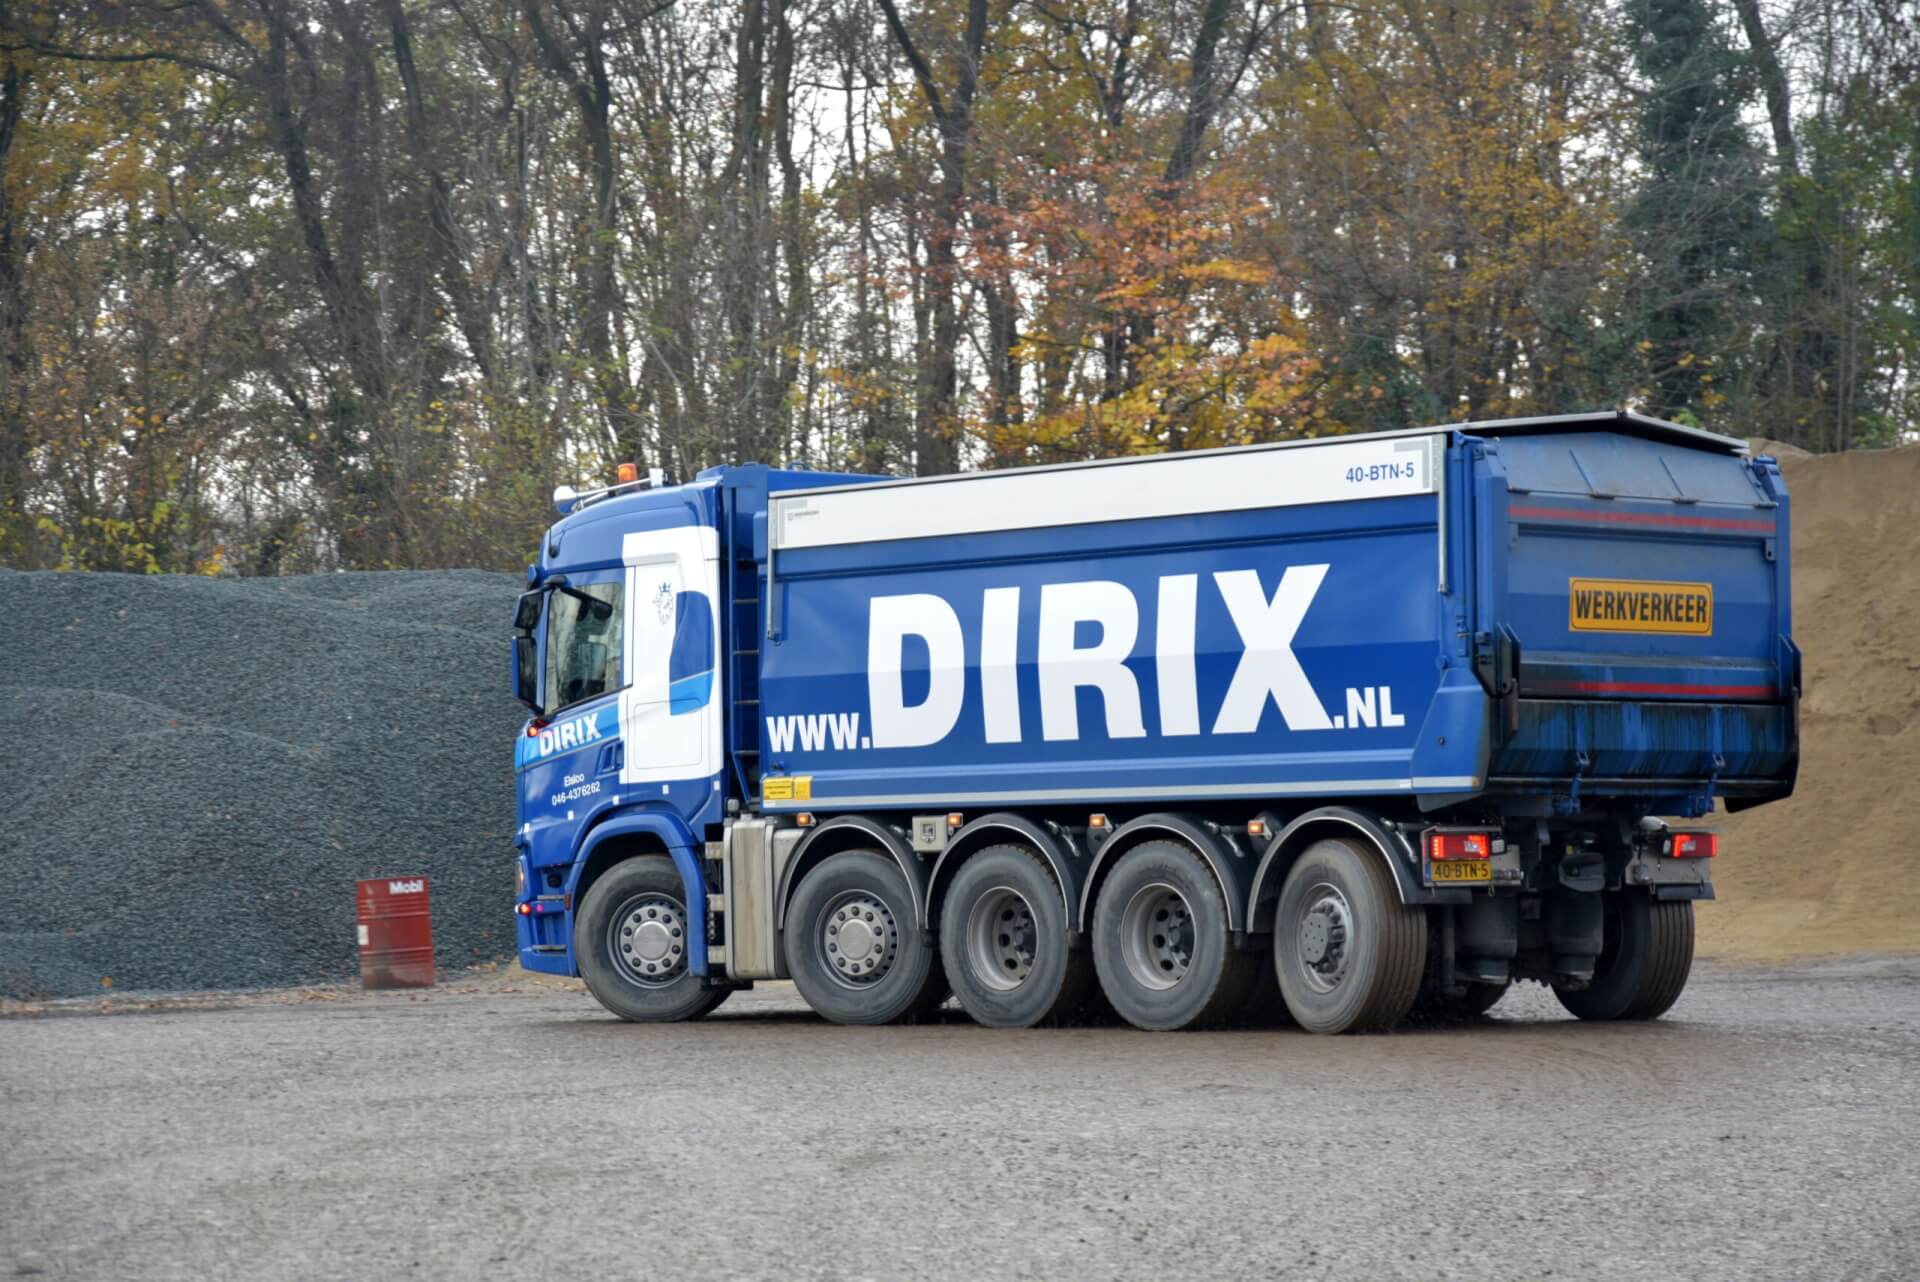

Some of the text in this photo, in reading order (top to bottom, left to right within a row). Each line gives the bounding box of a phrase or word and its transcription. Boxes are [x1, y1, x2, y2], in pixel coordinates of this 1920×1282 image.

[1346, 462, 1415, 482] 40-BTN-5
[1574, 589, 1707, 623] WERKVERKEER
[540, 712, 602, 757] DIRIX
[551, 781, 601, 806] 046-4376262
[1434, 862, 1489, 879] 40-BTN-5
